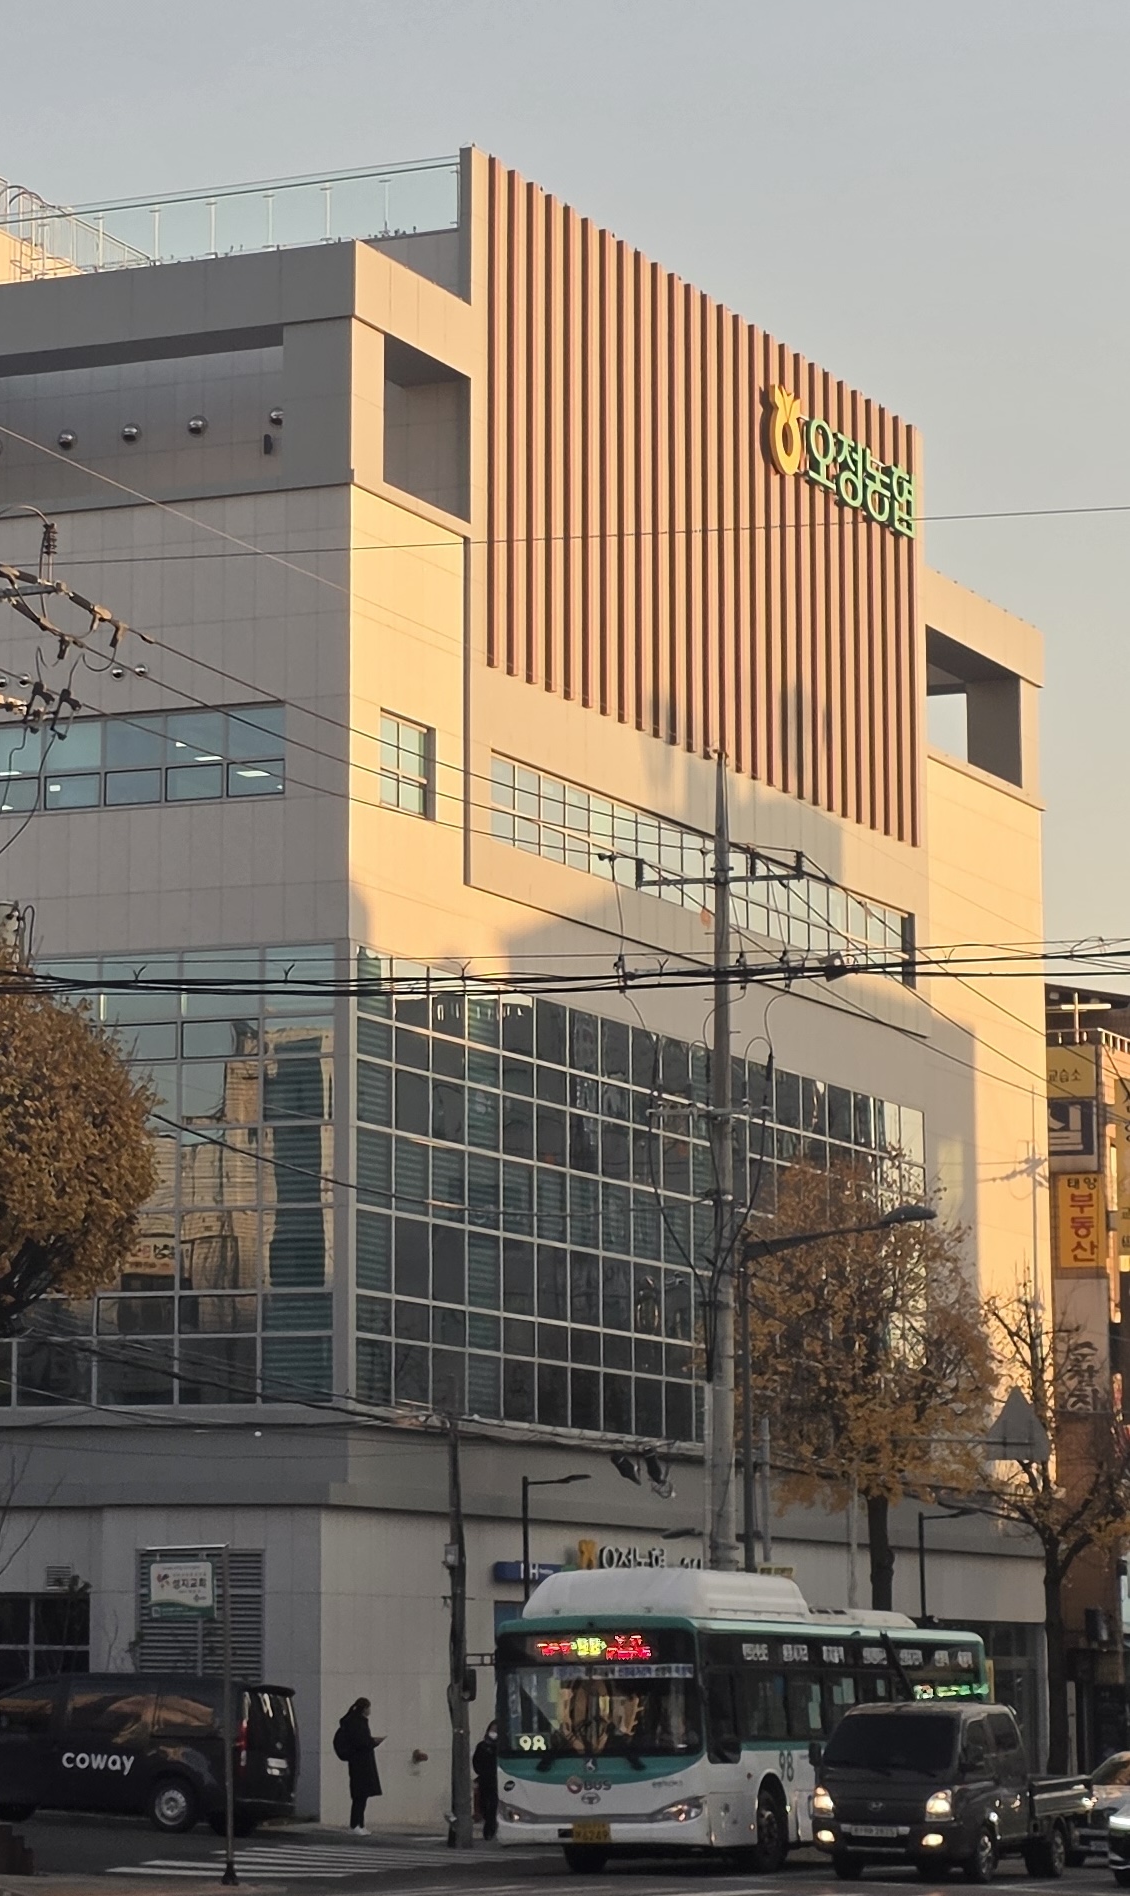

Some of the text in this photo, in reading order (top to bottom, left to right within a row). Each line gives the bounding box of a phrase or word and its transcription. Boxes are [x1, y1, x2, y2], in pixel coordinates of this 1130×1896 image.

[804, 417, 917, 540] 오정농협
[1067, 1177, 1097, 1191] 태양
[1069, 1193, 1098, 1264] 부동산
[519, 1735, 547, 1751] 98
[61, 1751, 135, 1776] coway
[778, 1751, 795, 1782] 98
